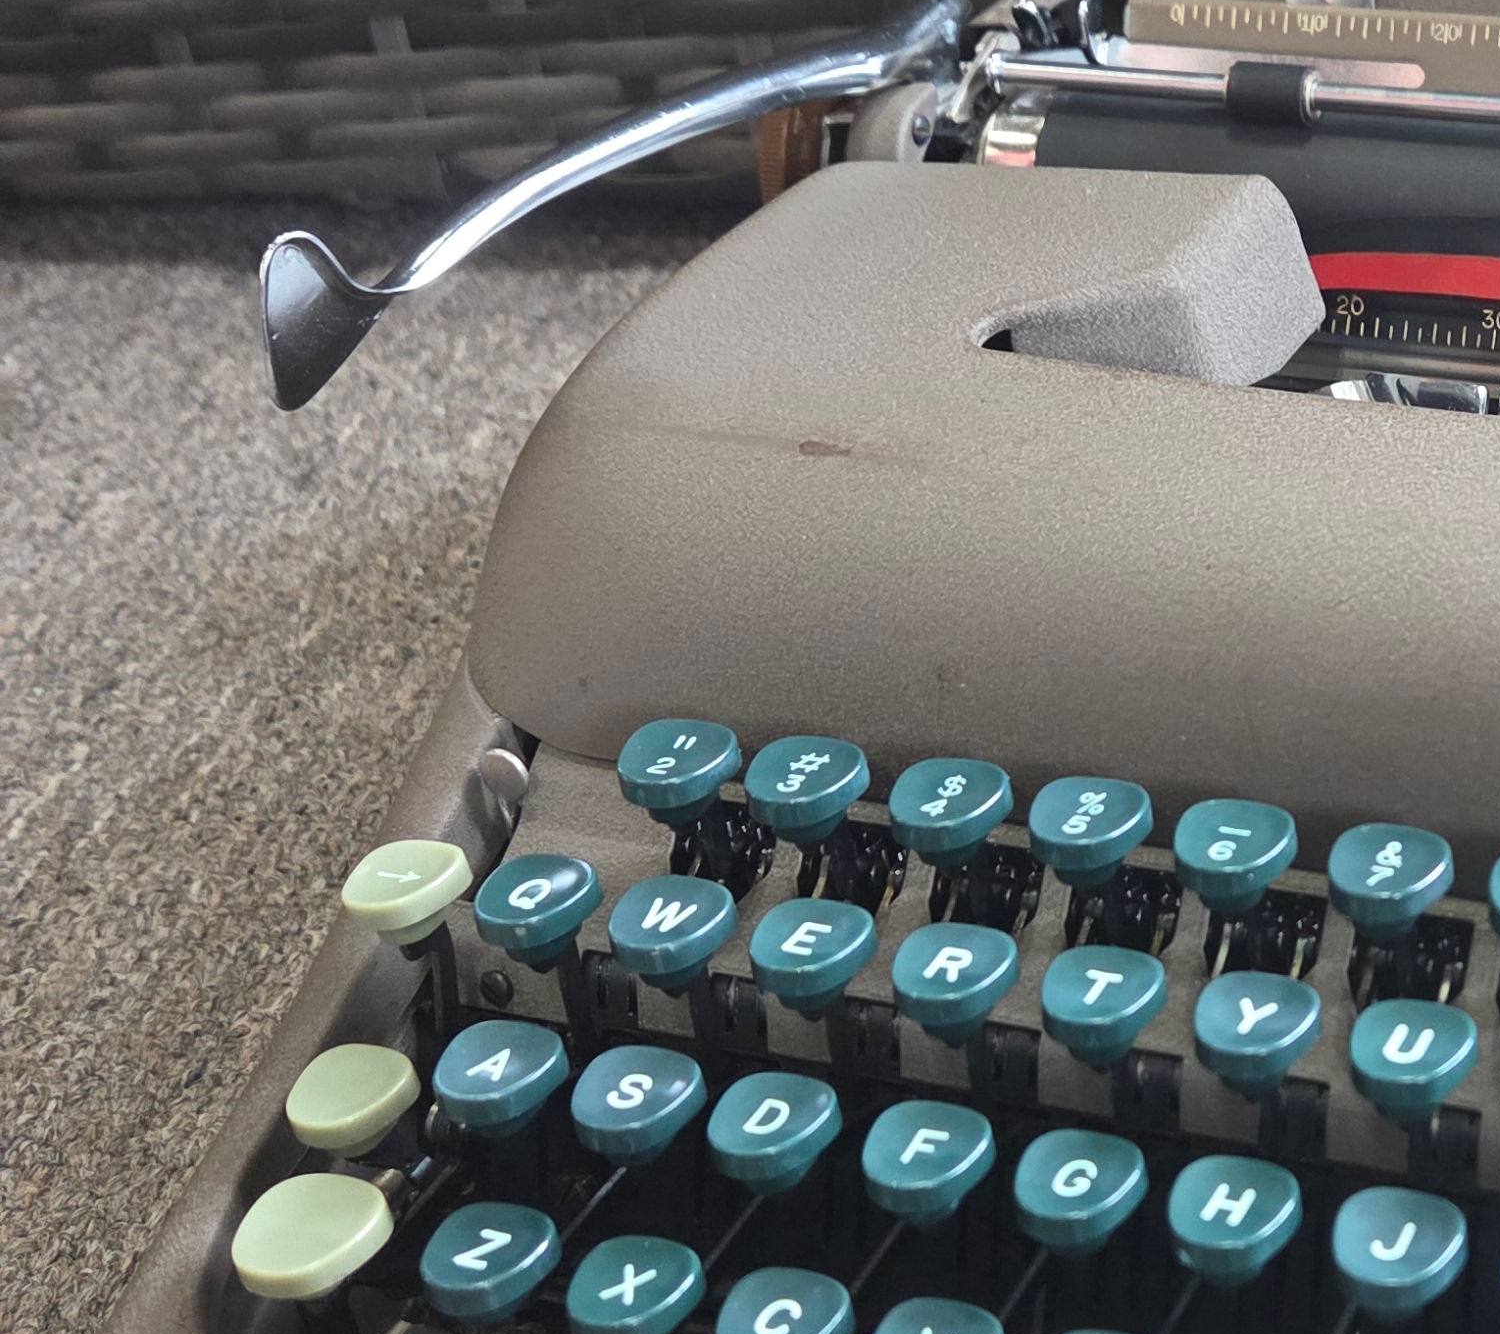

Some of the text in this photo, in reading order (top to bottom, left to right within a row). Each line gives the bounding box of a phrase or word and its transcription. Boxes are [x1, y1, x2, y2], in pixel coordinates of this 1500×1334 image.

[1301, 14, 1325, 34] 10
[1434, 23, 1460, 43] 20
[1336, 294, 1366, 316] 20
[646, 756, 676, 775] 2
[789, 752, 831, 774] #
[776, 773, 807, 793] 3
[937, 774, 967, 798] $
[919, 799, 948, 818] 4
[1078, 791, 1105, 816] %
[1061, 815, 1091, 835] 5
[1207, 840, 1238, 862] 6
[1375, 840, 1403, 869] &
[1365, 864, 1395, 888] 7
[508, 877, 552, 911] Q
[641, 897, 698, 934] W
[780, 921, 833, 957] E
[922, 946, 974, 984] R
[1082, 969, 1124, 1005] T
[1236, 997, 1279, 1035] Y
[1381, 1023, 1435, 1064] U
[465, 1048, 511, 1082] A
[605, 1073, 654, 1110] S
[742, 1098, 790, 1135] D
[899, 1127, 950, 1165] F
[1051, 1159, 1098, 1198] G
[1199, 1182, 1257, 1228] H
[452, 1228, 513, 1271] Z
[1369, 1222, 1417, 1262] J
[598, 1263, 658, 1307] X
